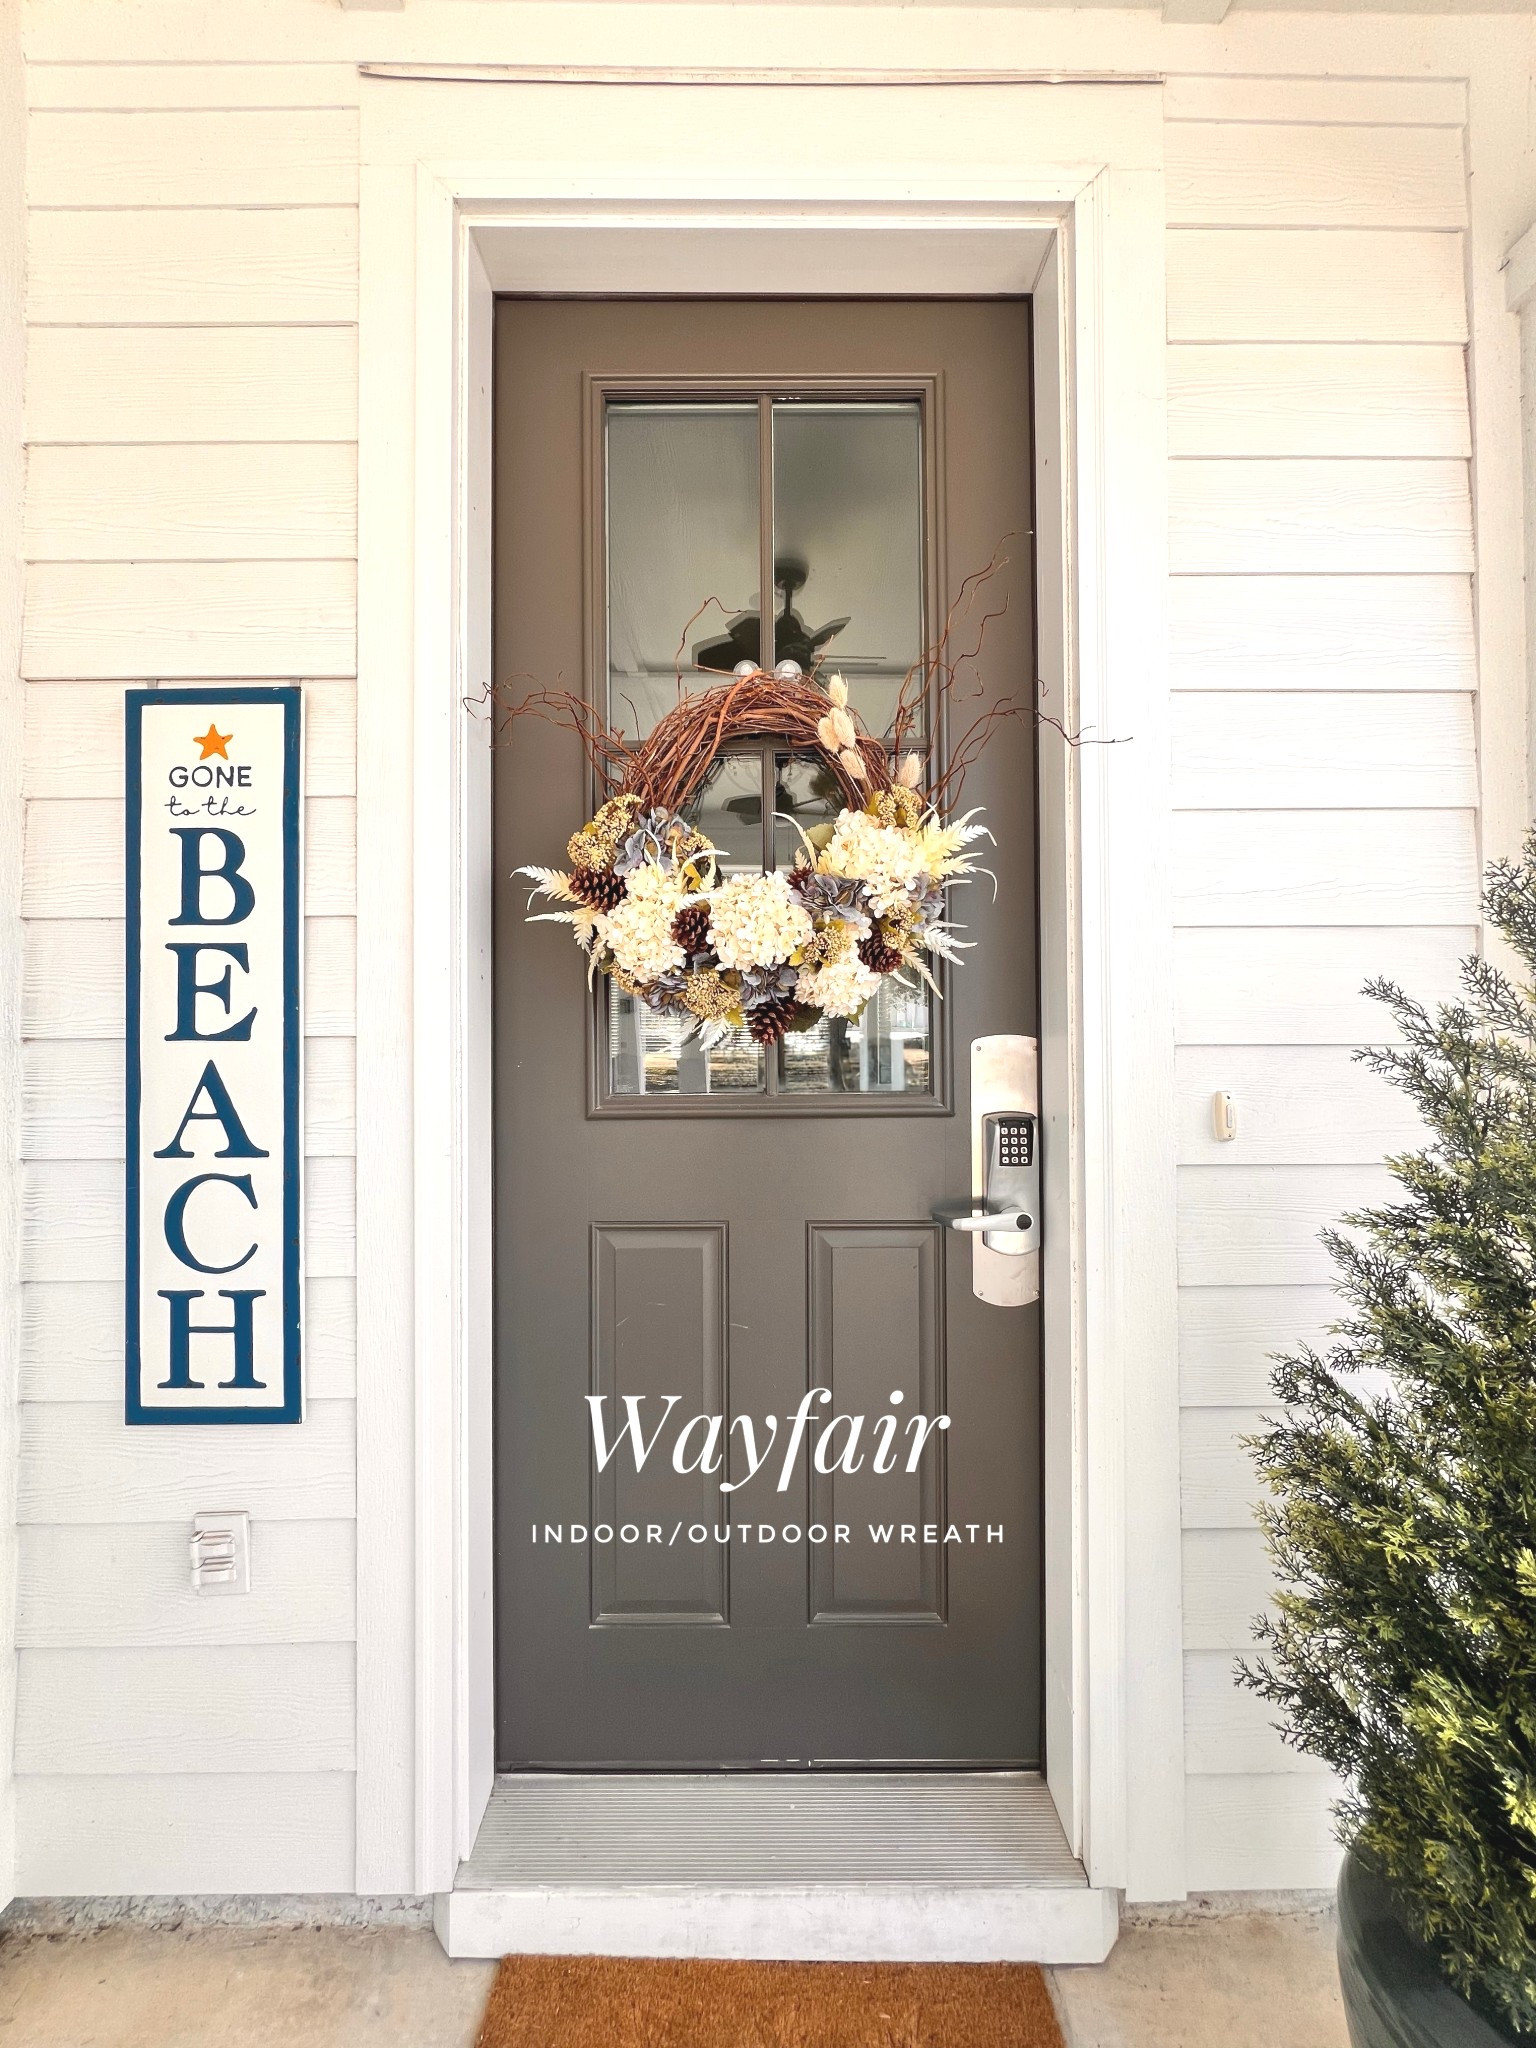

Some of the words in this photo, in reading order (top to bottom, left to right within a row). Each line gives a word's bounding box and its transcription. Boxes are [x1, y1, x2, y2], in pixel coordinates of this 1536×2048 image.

[168, 765, 252, 788] GONE
[164, 795, 200, 816] to
[201, 795, 256, 816] the
[153, 827, 270, 1389] BEACH
